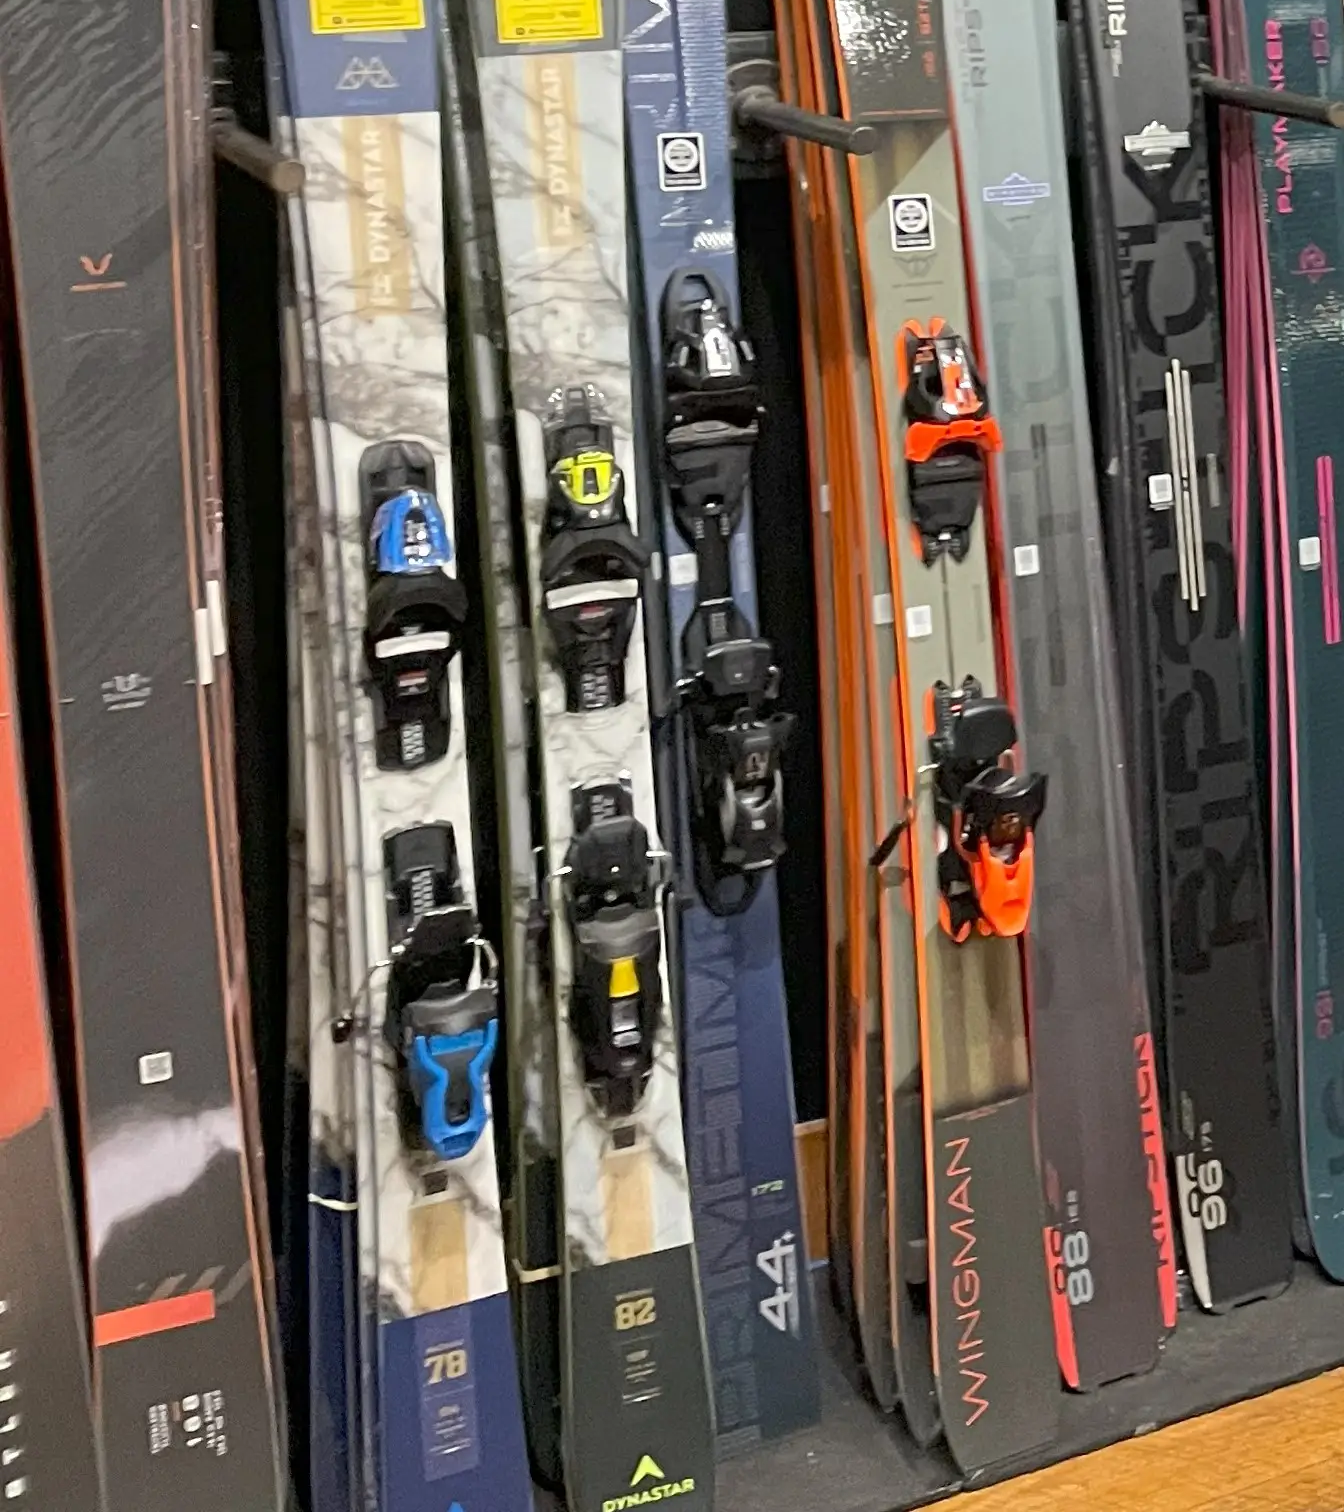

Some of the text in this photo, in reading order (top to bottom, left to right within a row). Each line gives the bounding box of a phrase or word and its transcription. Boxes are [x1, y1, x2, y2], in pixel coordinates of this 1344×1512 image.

[539, 67, 570, 196] DYNASTAR
[359, 129, 392, 264] DYNASTAR
[1196, 1159, 1228, 1231] 96
[944, 1135, 990, 1427] WINGMAN
[1063, 1230, 1096, 1306] 88
[614, 1292, 658, 1333] 82
[423, 1347, 468, 1387] 78
[602, 1477, 696, 1512] DYNASTAR
